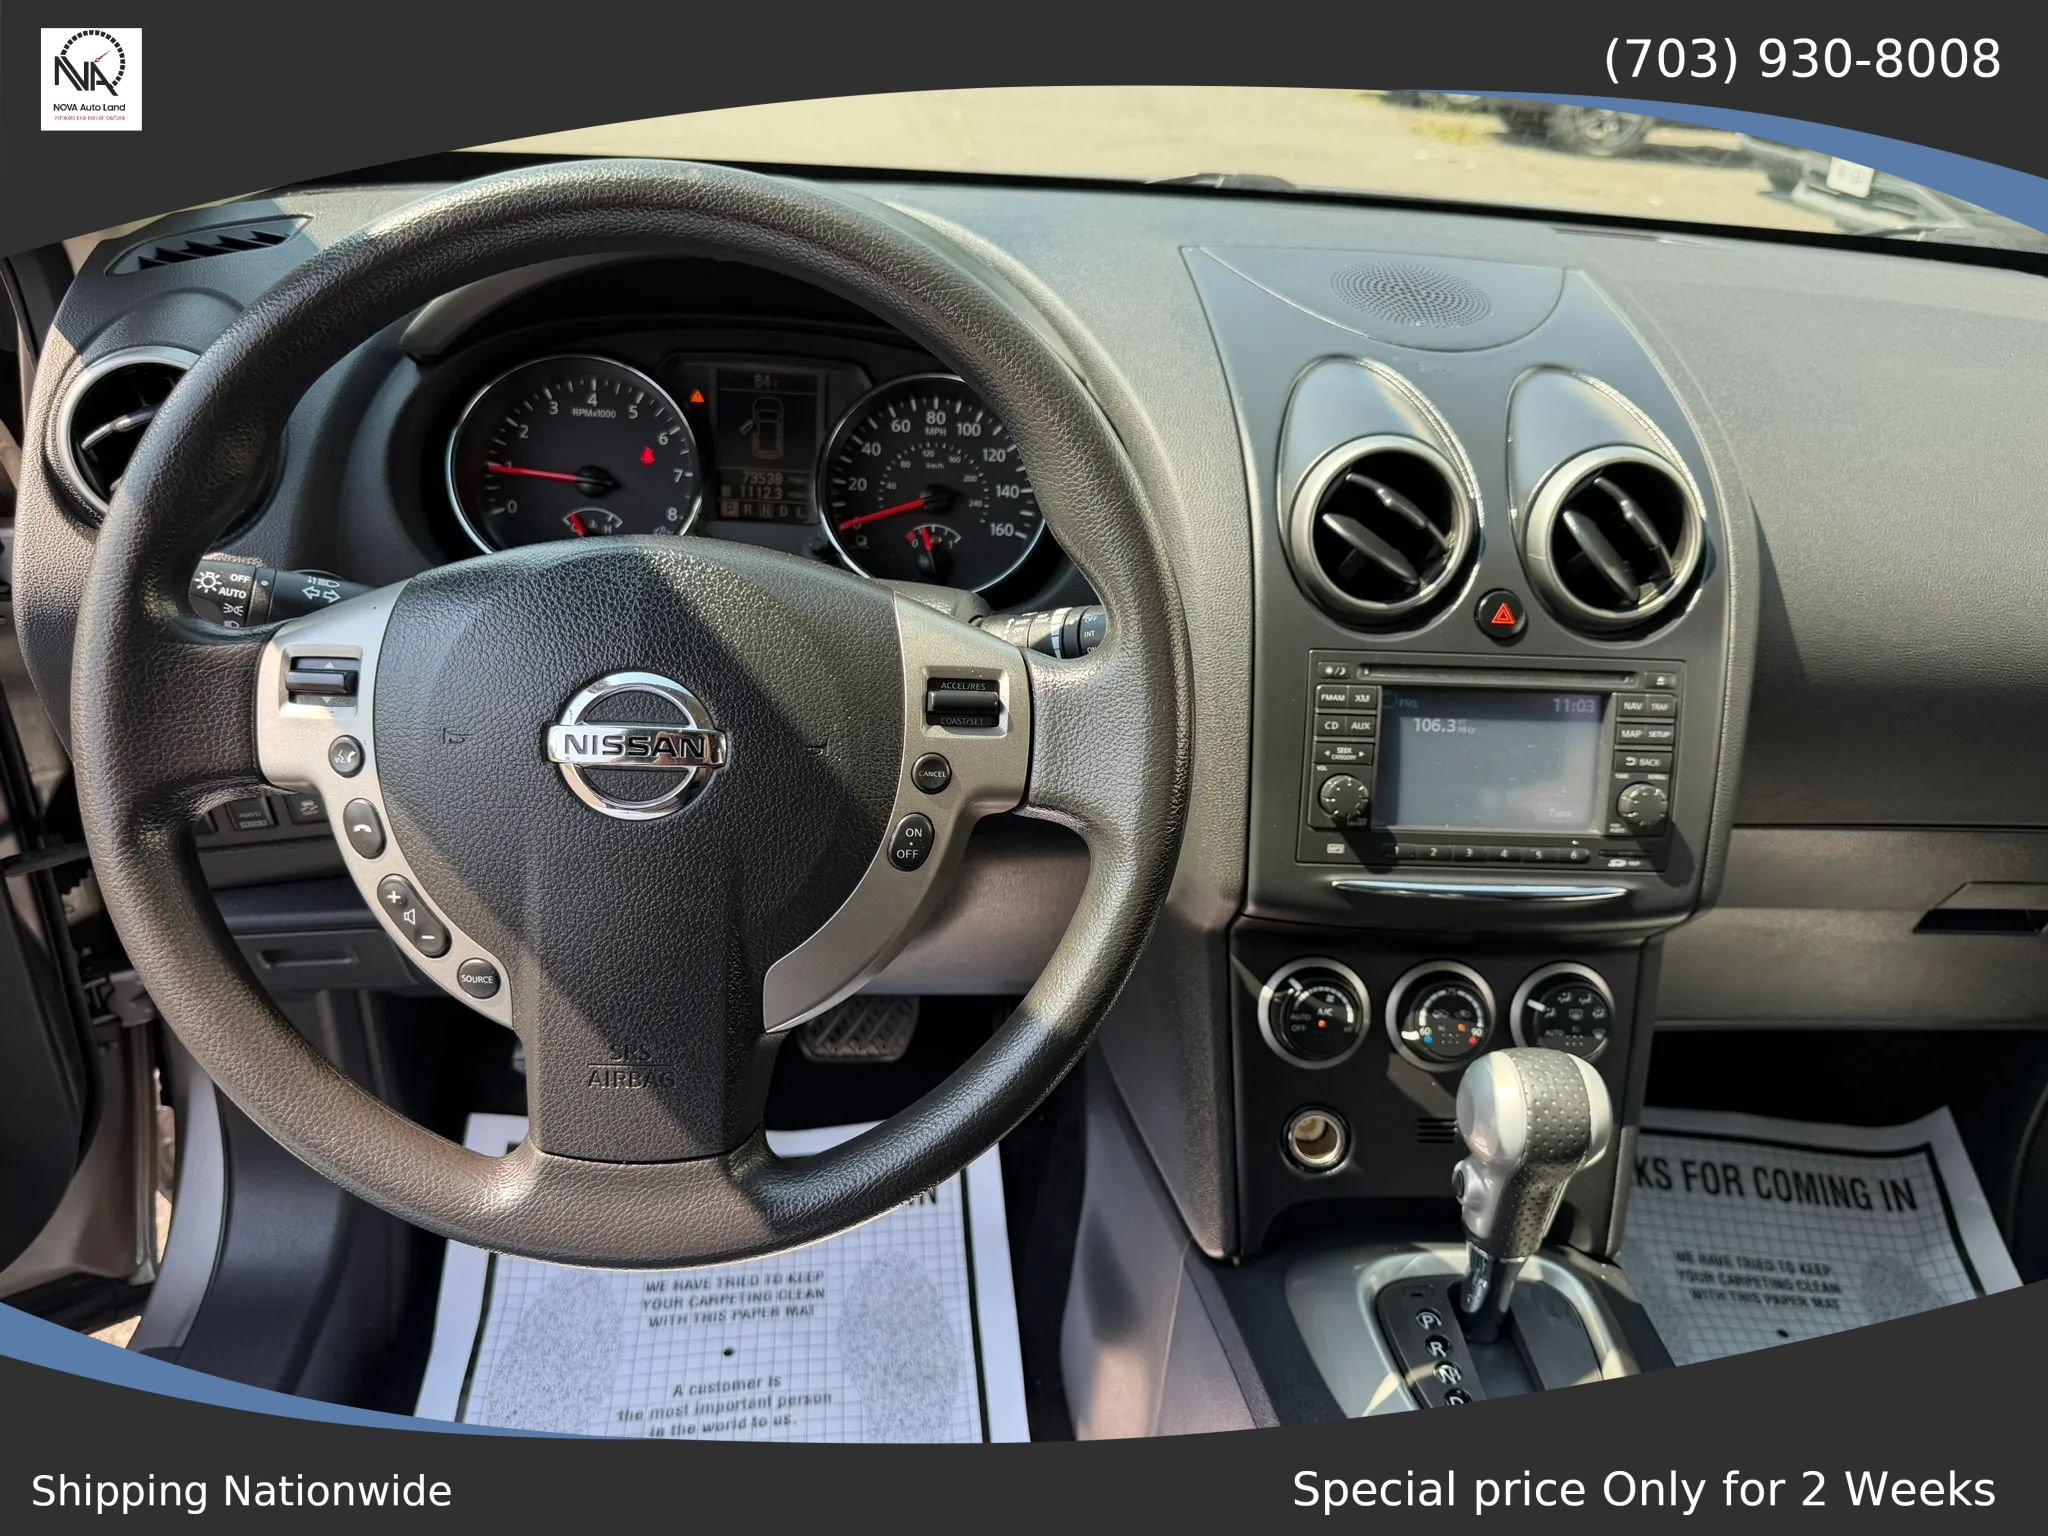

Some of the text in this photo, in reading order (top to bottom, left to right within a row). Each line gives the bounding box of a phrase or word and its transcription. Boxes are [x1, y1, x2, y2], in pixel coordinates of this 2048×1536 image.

[587, 392, 598, 406] 4
[550, 402, 559, 416] 3
[628, 405, 638, 420] 5
[926, 411, 946, 424] 80
[519, 424, 530, 440] 2
[892, 420, 911, 433] 60
[925, 426, 946, 437] MPH
[957, 422, 981, 436] 100
[658, 432, 669, 445] 6
[862, 442, 881, 456] 40
[983, 448, 1006, 462] 120
[674, 470, 684, 482] 7
[849, 477, 867, 491] 20
[996, 485, 1019, 498] 140
[507, 500, 518, 514] 0
[667, 507, 678, 521] 8
[990, 522, 1014, 536] 160
[230, 573, 251, 583] OFF
[218, 588, 247, 599] AUTO
[1084, 630, 1095, 638] INT
[940, 682, 986, 691] ACCEL/RES
[1553, 699, 1595, 713] 11:03
[1624, 702, 1642, 710] NAV
[1324, 721, 1371, 730] CD AUX
[1414, 718, 1456, 733] 106.3
[1621, 730, 1642, 738] MAP
[564, 733, 706, 760] NISSAN
[1639, 758, 1660, 766] BACK
[918, 770, 946, 778] CANCEL
[905, 827, 922, 838] ON
[896, 849, 919, 859] OFF
[1430, 848, 1438, 857] 2
[1466, 848, 1473, 857] 3
[1500, 849, 1507, 858] 4
[1535, 850, 1543, 859] 5
[1570, 850, 1578, 859] 6
[461, 974, 494, 984] SOURCE
[1420, 1027, 1432, 1036] 60
[610, 1044, 652, 1062] SRS
[588, 1069, 676, 1089] AIRBAG
[1680, 1159, 1744, 1198] FOR
[1752, 1165, 1873, 1211] COMING
[1879, 1177, 1918, 1212] IN
[645, 1270, 824, 1293] WE HAVE TRIED TO KEEP
[642, 1288, 825, 1311] YOUR CARPETING CLEAN
[650, 1304, 815, 1328] WITH THIS PAPER MAT
[1422, 1315, 1434, 1330] P
[1430, 1341, 1447, 1358] R
[1438, 1366, 1458, 1384] N
[672, 1374, 782, 1398] A customer is
[617, 1391, 833, 1422] the most important person
[650, 1412, 796, 1438] in the world to us.
